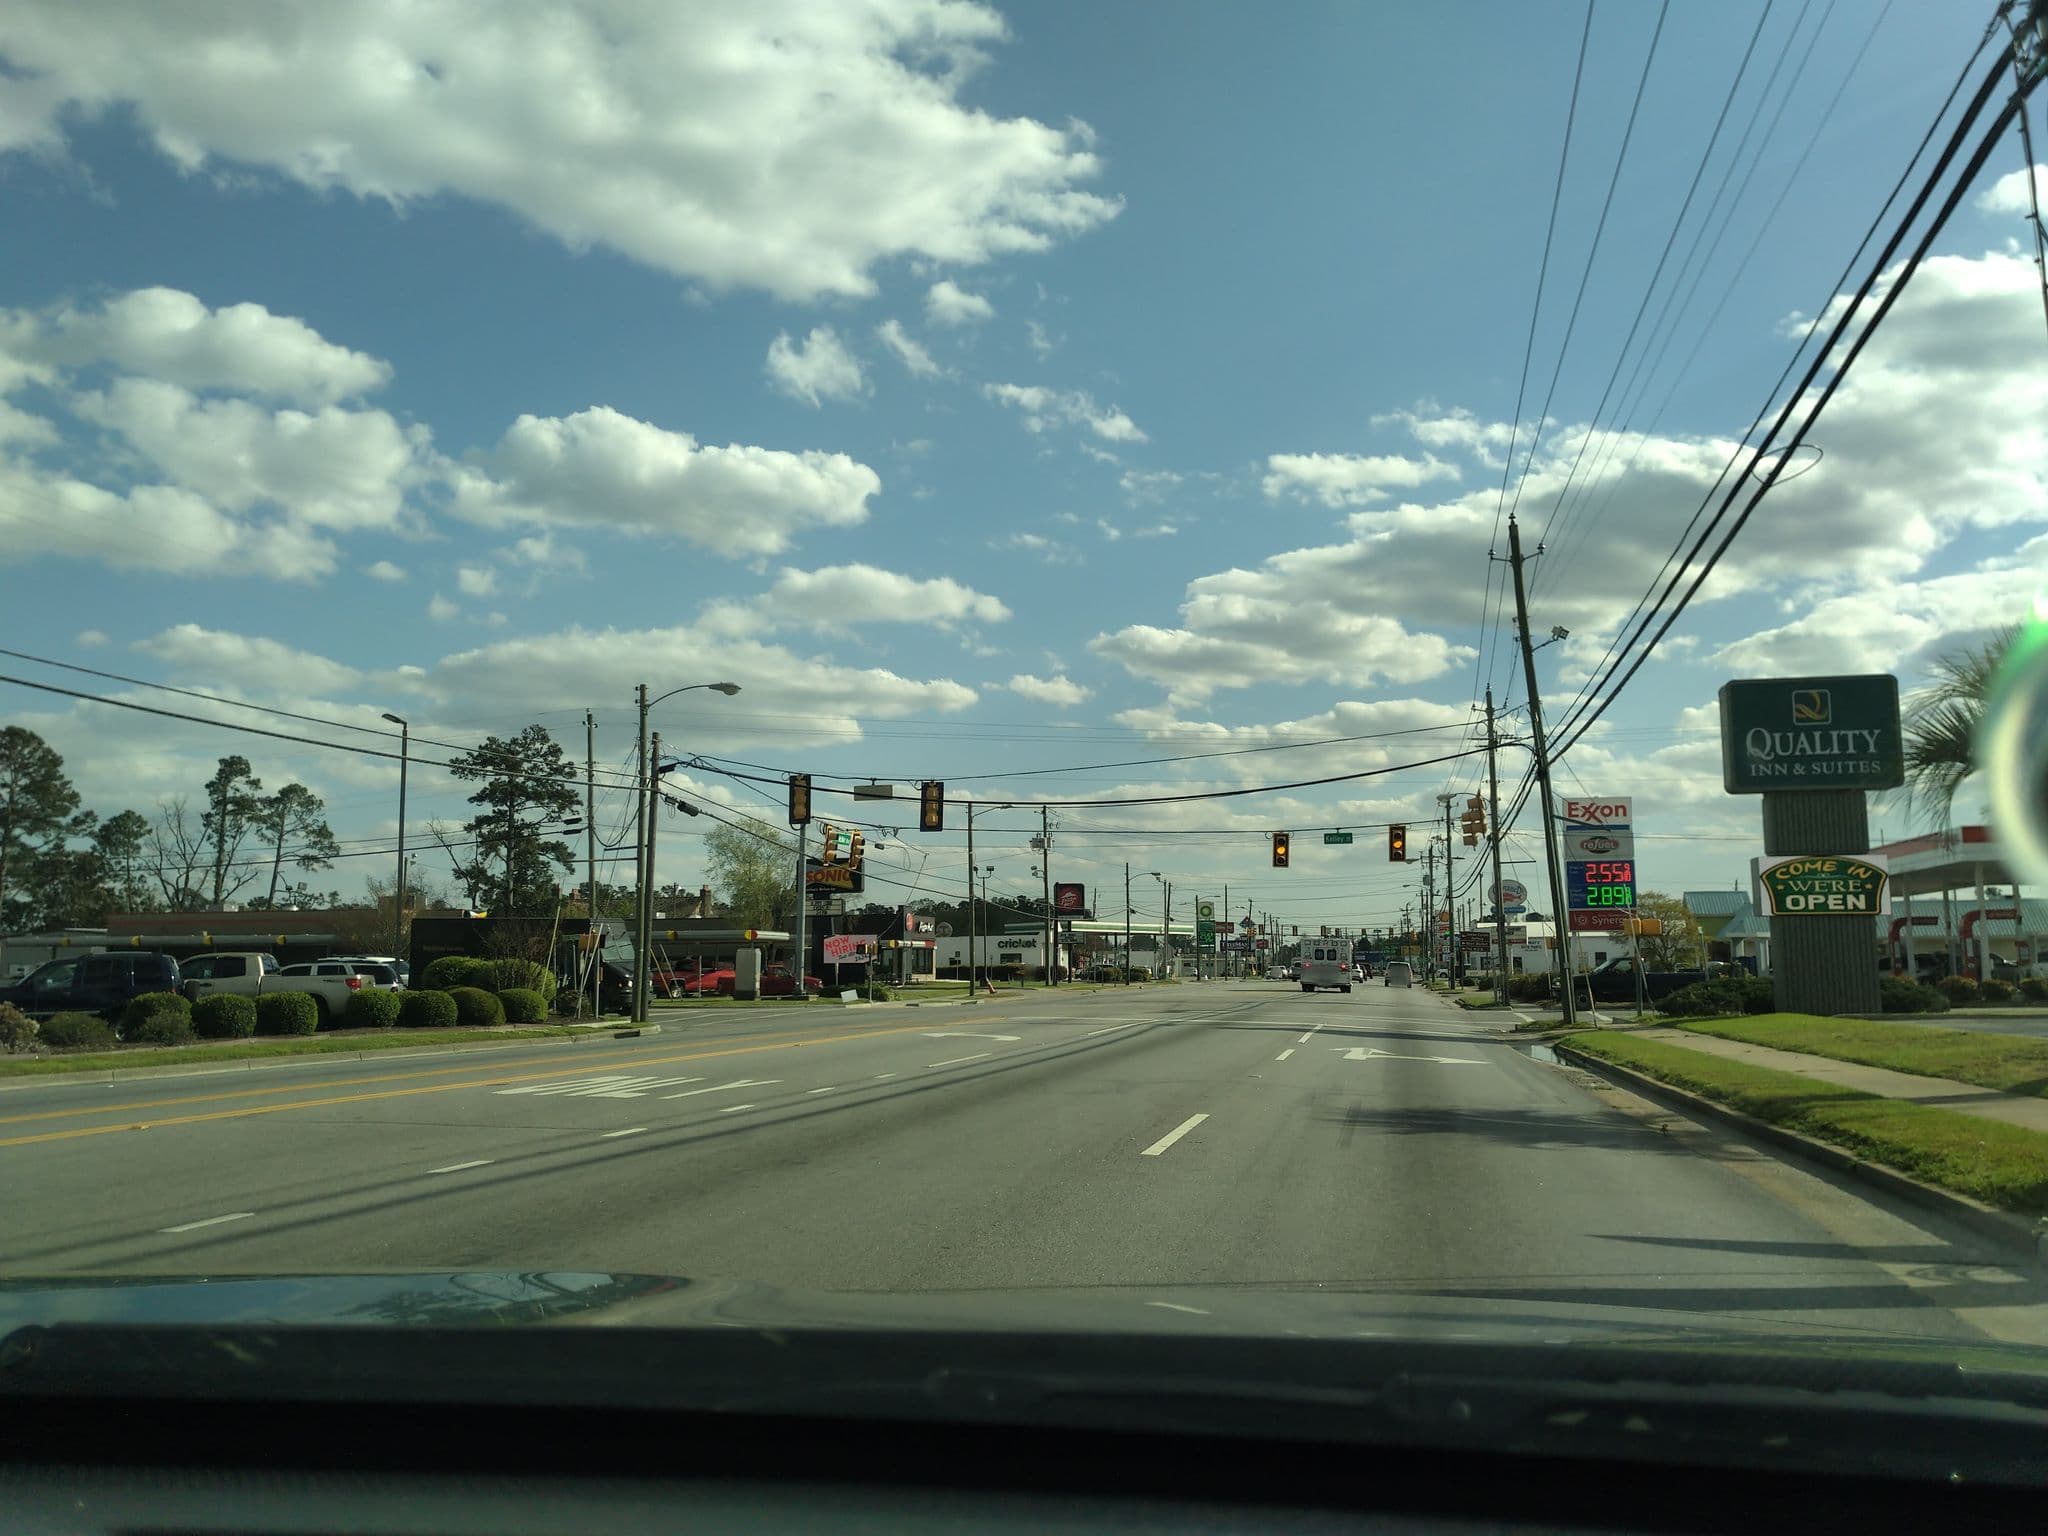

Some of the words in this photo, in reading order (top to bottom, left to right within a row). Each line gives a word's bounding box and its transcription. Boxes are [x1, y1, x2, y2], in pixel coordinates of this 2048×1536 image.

[1746, 728, 1881, 760] QUALITY
[1751, 763, 1788, 776] INN
[1793, 763, 1806, 774] &
[1812, 760, 1881, 775] SUITES
[1567, 801, 1627, 824] Exxon
[805, 869, 850, 883] SONIC
[1775, 860, 1837, 879] COME
[1785, 894, 1866, 910] OPEN
[1591, 915, 1624, 927] Synerg
[825, 936, 849, 951] NOW
[997, 939, 1037, 949] cricket
[491, 1075, 785, 1100] ONLY
